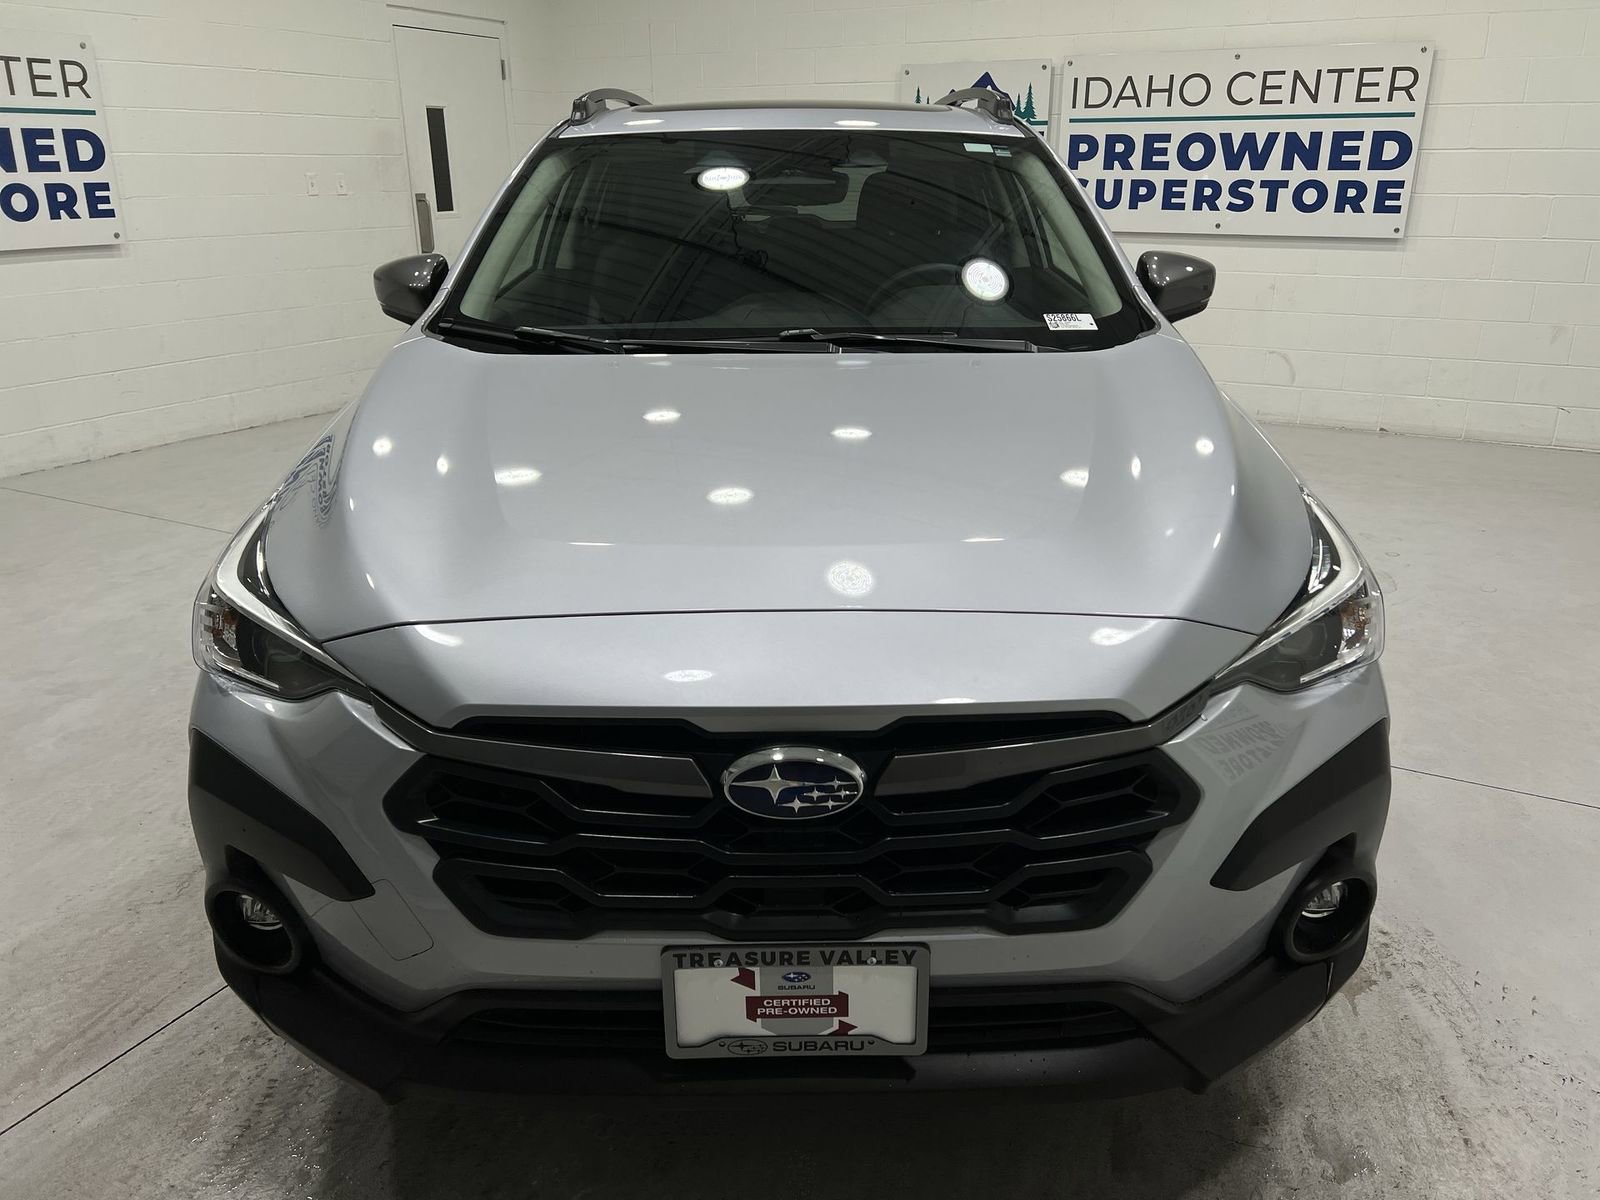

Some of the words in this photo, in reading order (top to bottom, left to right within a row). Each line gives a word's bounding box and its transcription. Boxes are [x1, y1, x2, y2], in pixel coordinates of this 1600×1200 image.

[1070, 72, 1212, 110] IDAHO
[1226, 65, 1420, 106] CENTER
[1067, 130, 1414, 172] PREOWNED
[0, 181, 116, 223] ORE
[1078, 178, 1405, 214] UPERSTORE
[672, 950, 811, 969] TREASURE
[819, 949, 918, 966] VALLEY
[757, 1006, 838, 1015] PRE-OWNED
[763, 998, 831, 1007] CERTIFIED
[772, 1040, 865, 1052] SUBARU
